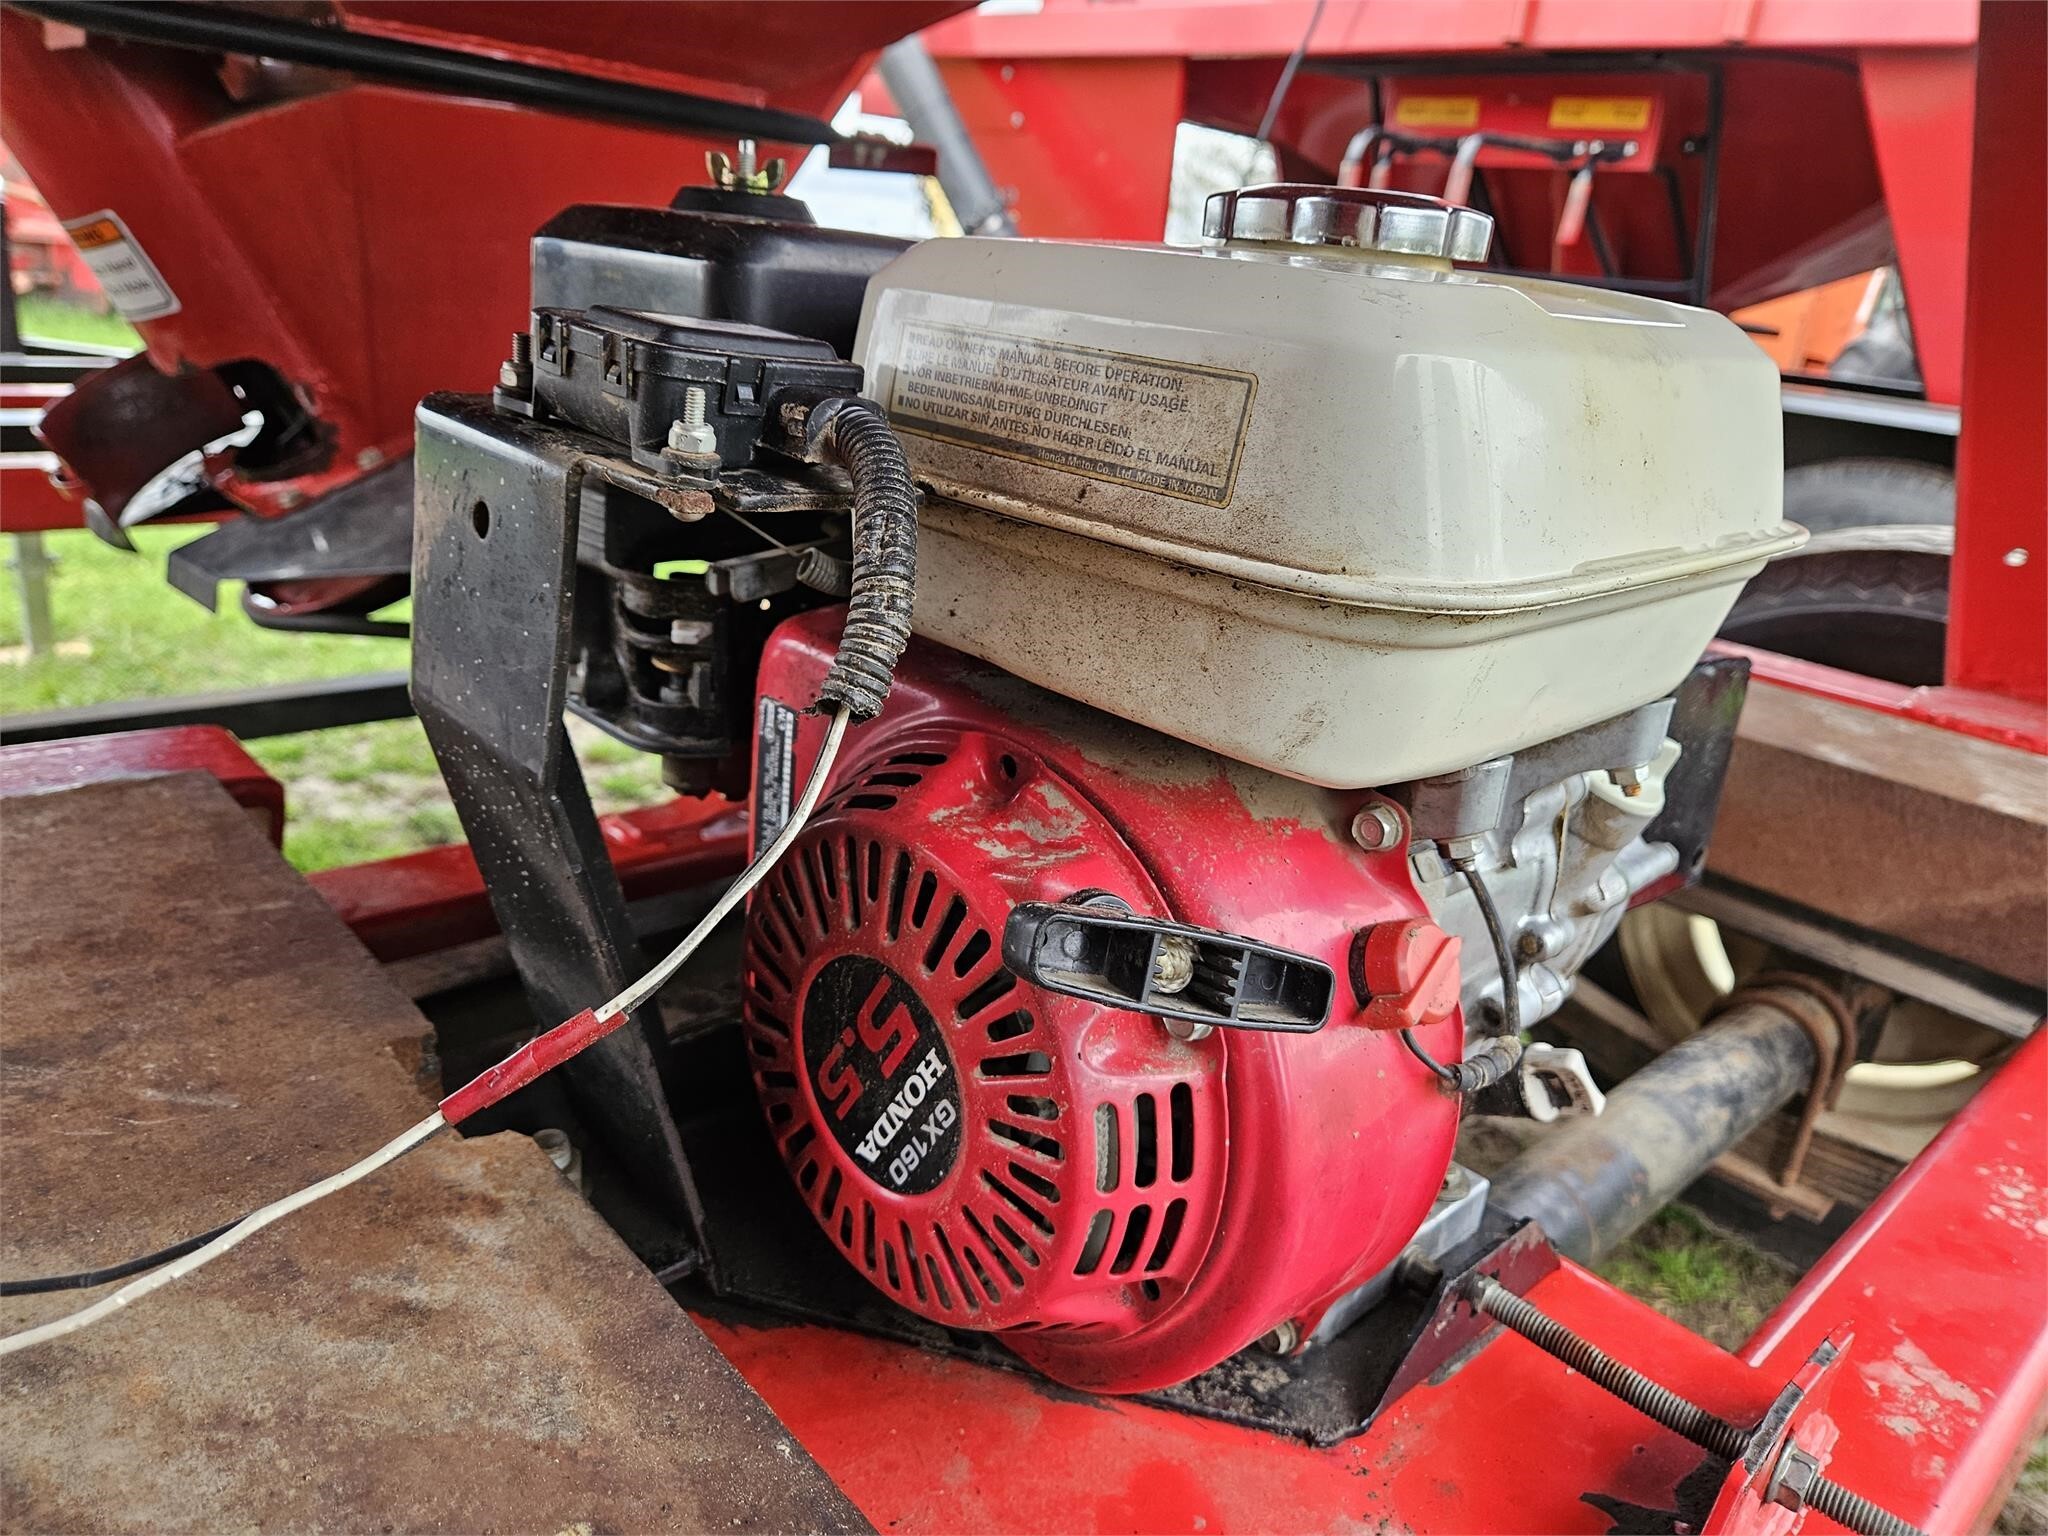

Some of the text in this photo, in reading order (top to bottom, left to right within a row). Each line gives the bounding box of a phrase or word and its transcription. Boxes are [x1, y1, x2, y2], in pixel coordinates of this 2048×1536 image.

[912, 366, 932, 379] VOR
[1034, 390, 1107, 415] UNBEDINGT
[937, 353, 948, 366] LE
[951, 356, 998, 377] MANUEL
[1001, 366, 1088, 392] D'UTILISATEUR
[1092, 383, 1137, 402] AVANT
[946, 338, 996, 358] OWNER'S
[999, 348, 1050, 368] MANUAL
[1053, 357, 1101, 377] BEFORE
[1105, 366, 1184, 392] OPERATION.
[907, 380, 1041, 419] BEDIENUNGSANLEITUNG
[904, 397, 920, 409] NO
[923, 400, 970, 422] UTILIZAR
[970, 410, 989, 426] SIN
[990, 416, 1028, 434] ANTES
[1031, 424, 1050, 439] NO
[1053, 430, 1094, 449] HABER
[1097, 439, 1134, 458] LEIDO
[1137, 448, 1152, 462] EL
[1038, 448, 1065, 464] Honda
[1068, 456, 1094, 471] Motor
[1135, 471, 1168, 488] MADE
[1168, 479, 1180, 490] IN
[1181, 482, 1218, 499] JAPAN
[818, 974, 920, 1121] 5.5
[855, 1047, 948, 1163] HONDA
